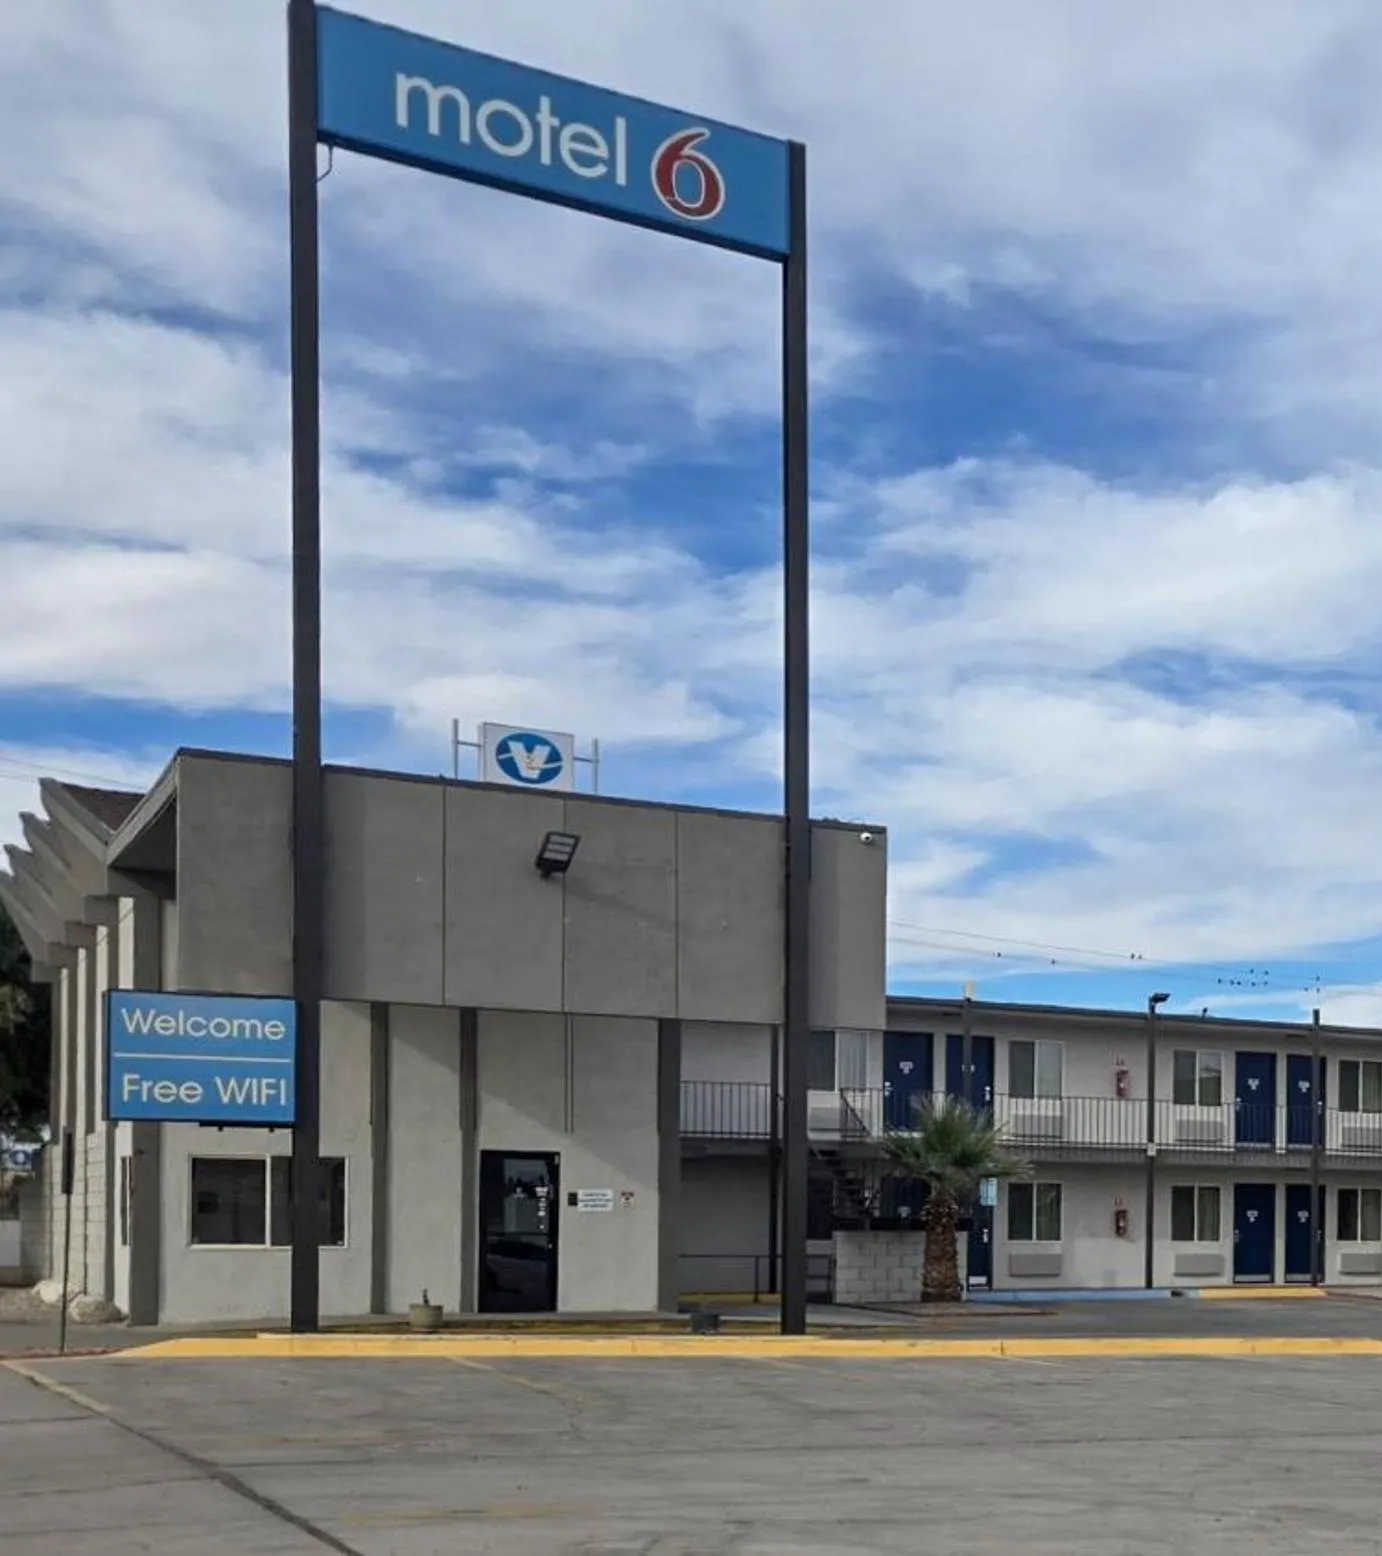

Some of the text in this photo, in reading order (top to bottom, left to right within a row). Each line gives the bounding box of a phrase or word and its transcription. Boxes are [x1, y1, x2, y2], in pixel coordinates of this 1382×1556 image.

[395, 72, 726, 221] motel 6
[121, 1008, 286, 1040] Welcome
[122, 1073, 203, 1104] Free
